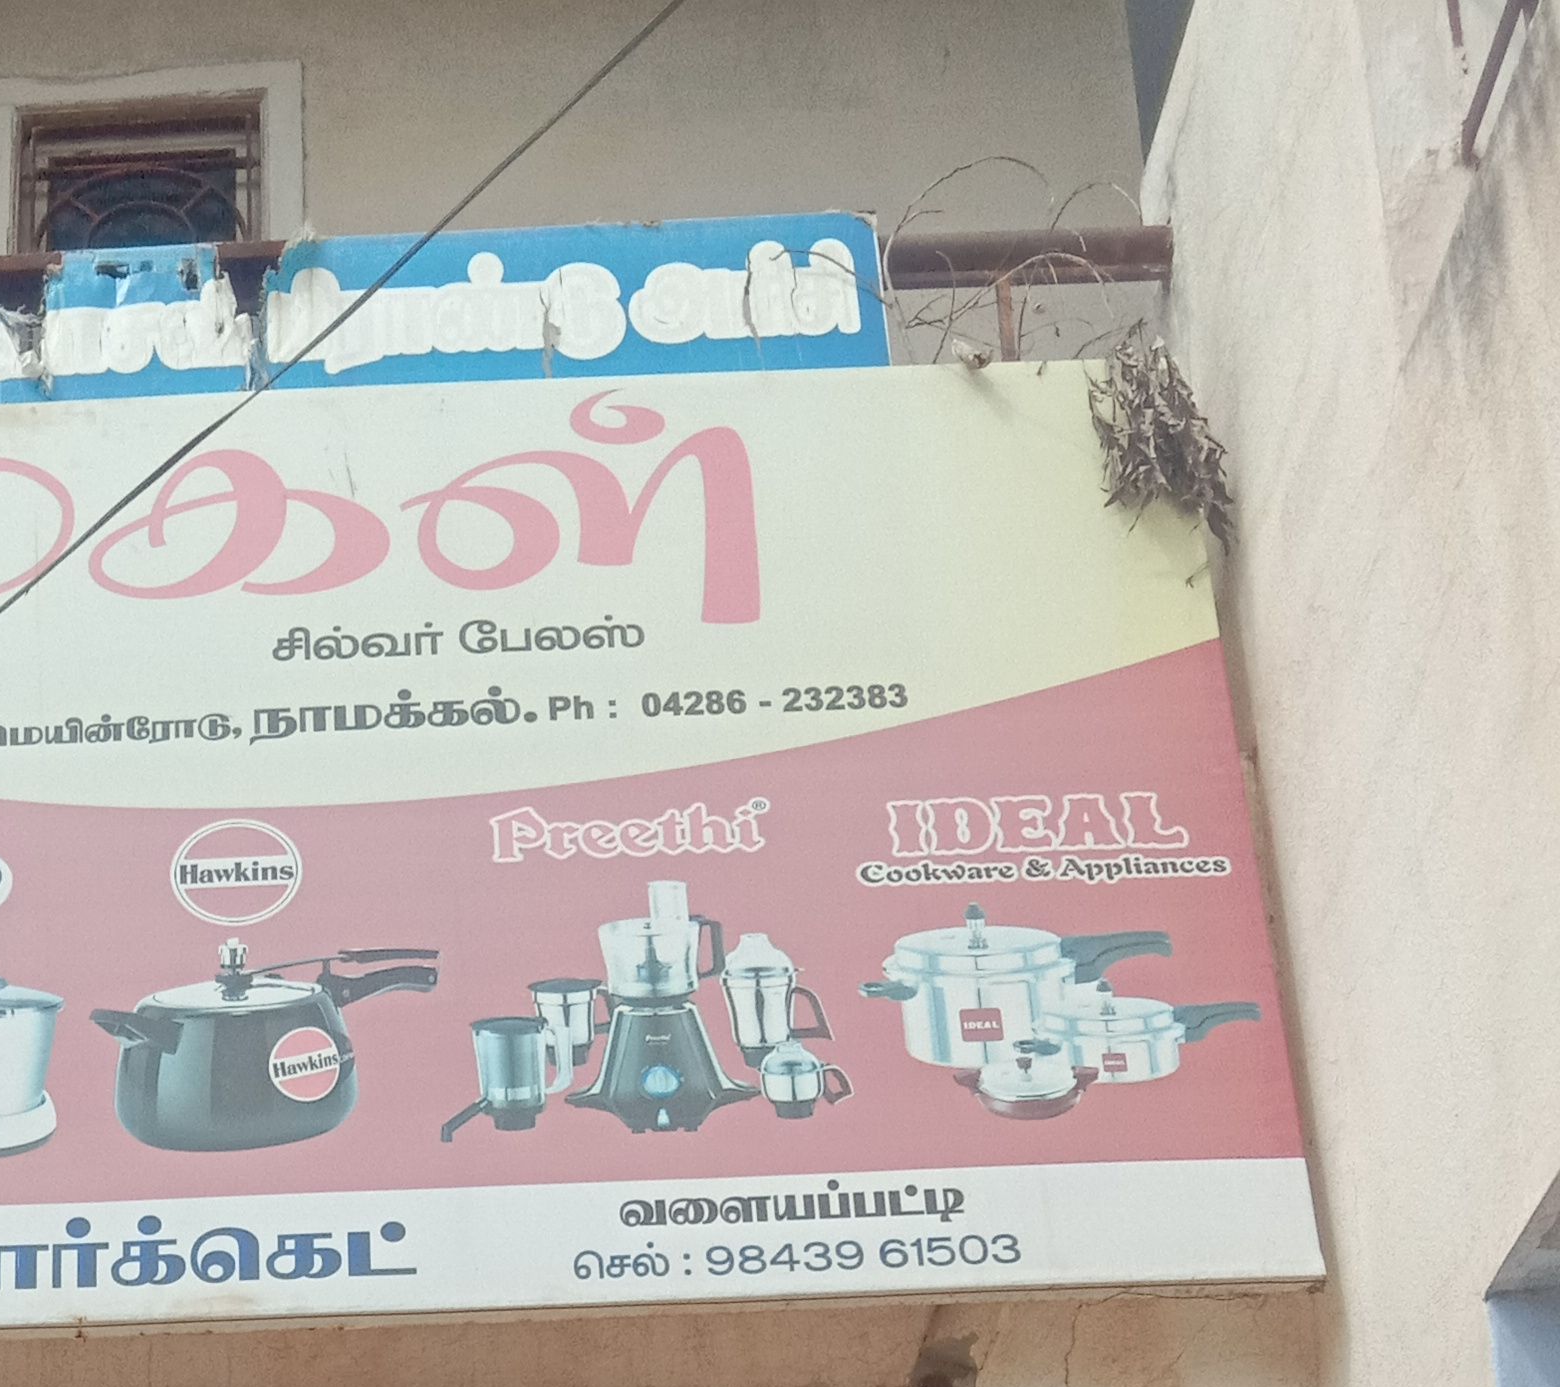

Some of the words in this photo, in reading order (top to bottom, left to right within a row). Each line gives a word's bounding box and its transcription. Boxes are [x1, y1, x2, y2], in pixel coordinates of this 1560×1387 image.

[271, 621, 445, 662] சில்வர்
[458, 614, 646, 655] பேலஸ்
[249, 685, 539, 746] நாமக்கல்.
[547, 693, 595, 722] Ph
[640, 687, 748, 719] 04286
[781, 681, 910, 715] 232383
[491, 800, 767, 864] Preethi
[886, 792, 1190, 857] IDEAL
[178, 857, 295, 889] Hawkins
[857, 860, 1020, 887] Cookware
[1023, 856, 1053, 882] &
[1058, 853, 1230, 885] Appliances
[961, 1018, 1001, 1031] IDEAL
[271, 1047, 340, 1081] Hawkins
[619, 1178, 966, 1228] வளையப்பட்டி
[572, 1240, 672, 1281] செல்
[705, 1239, 865, 1277] 98439
[879, 1232, 1023, 1270] 61503
